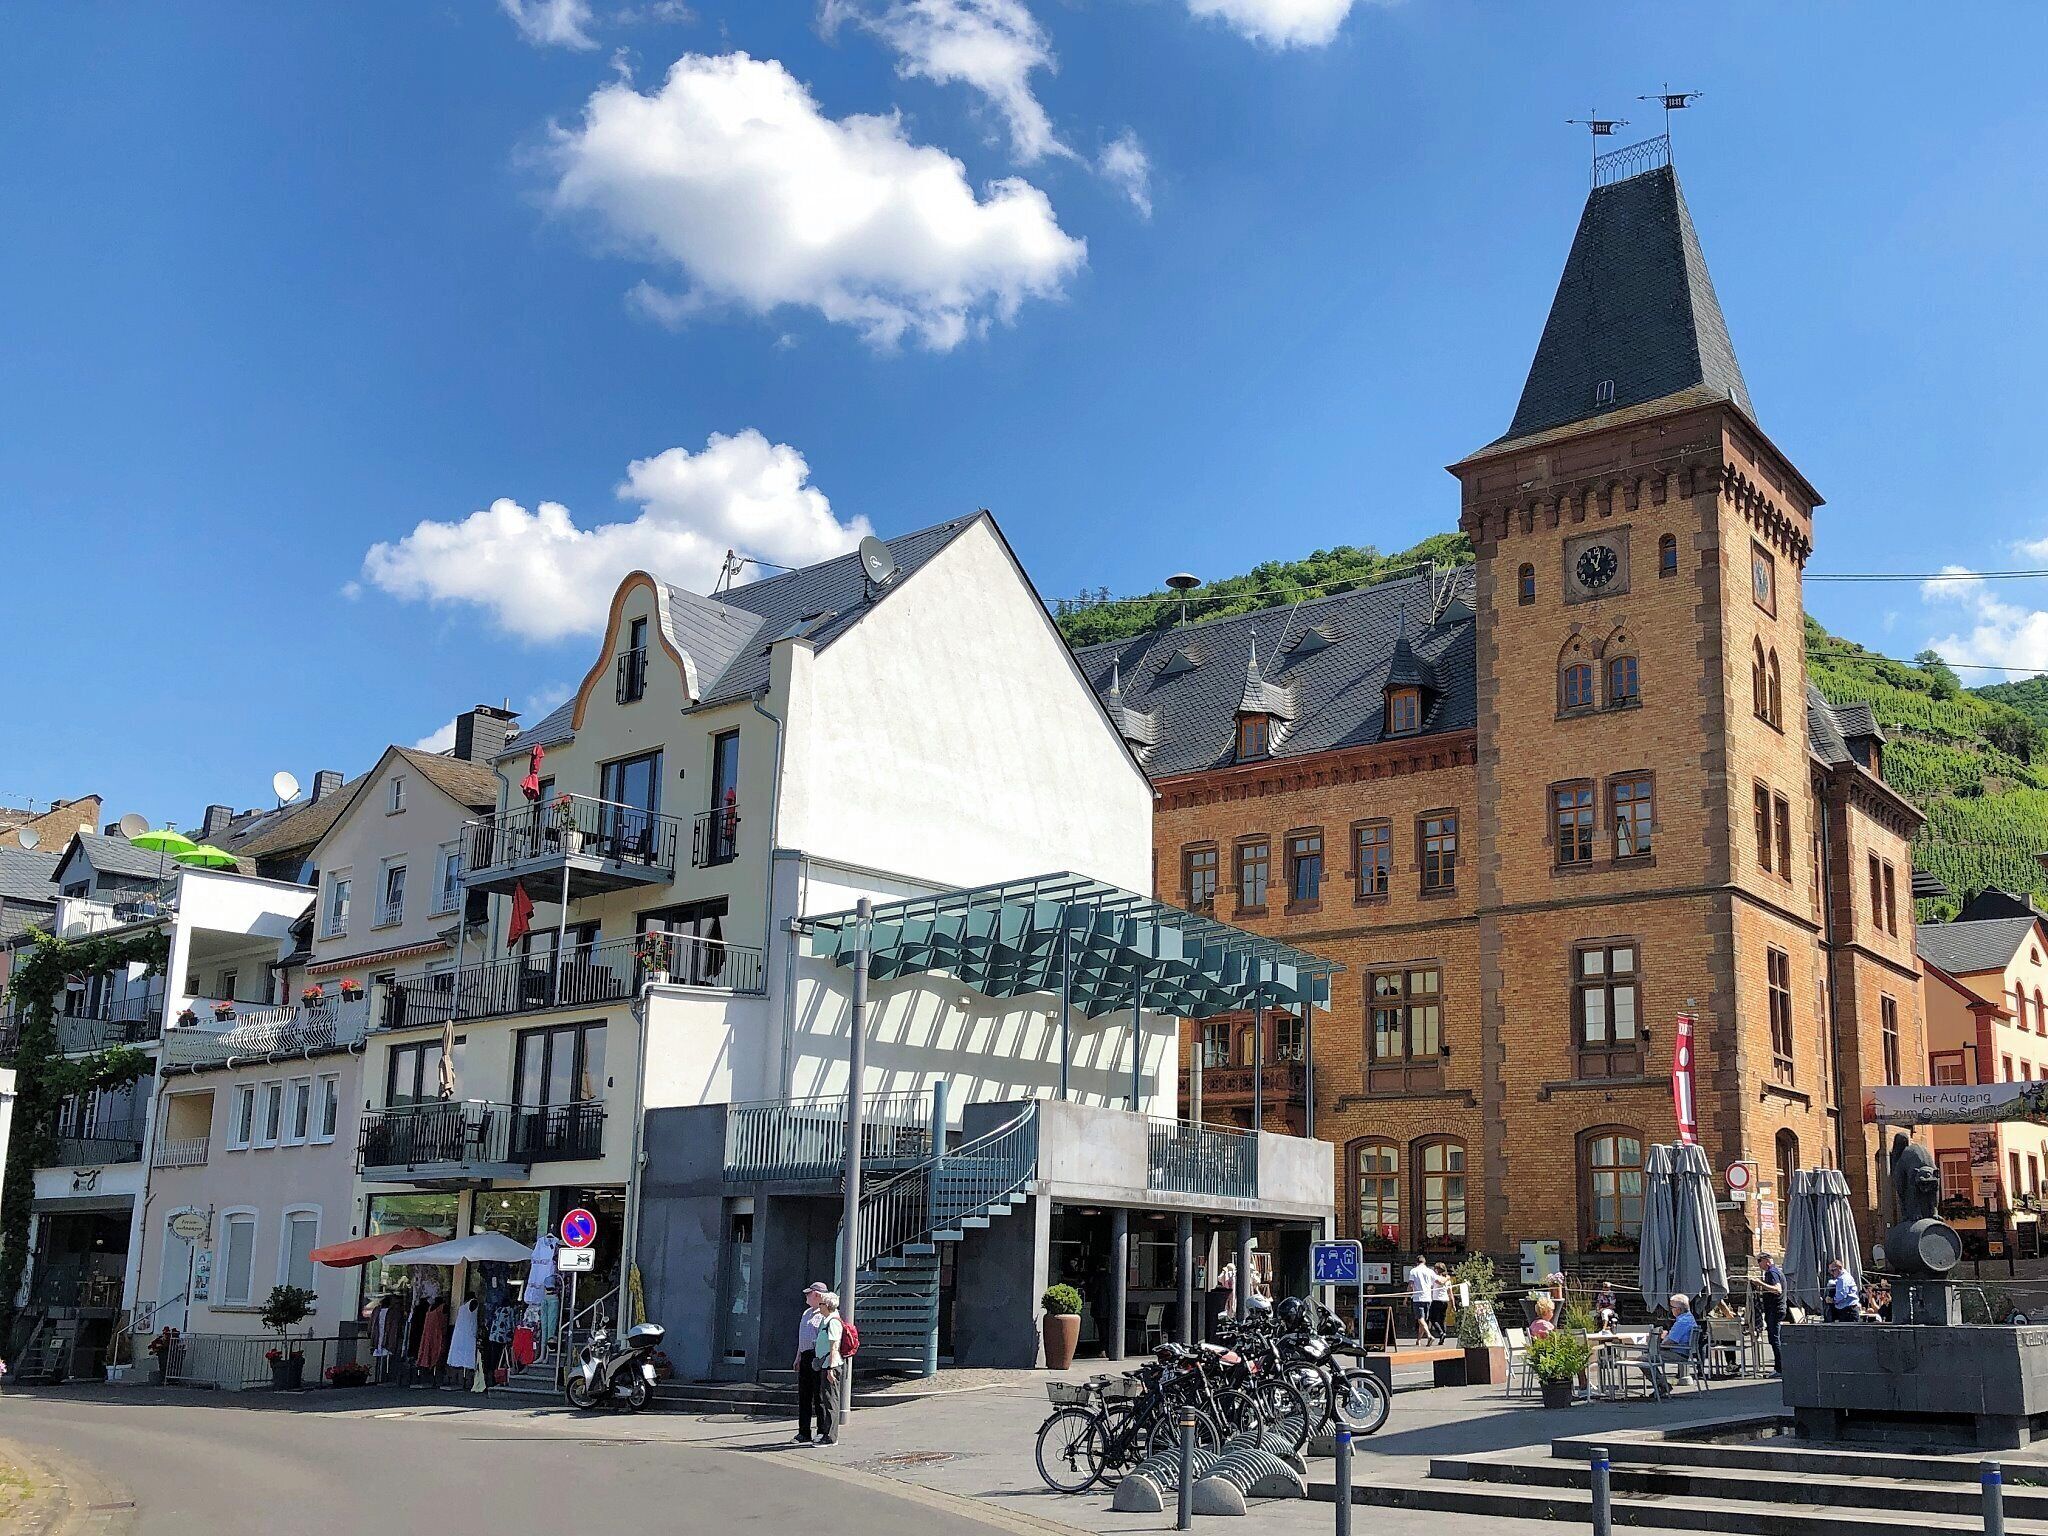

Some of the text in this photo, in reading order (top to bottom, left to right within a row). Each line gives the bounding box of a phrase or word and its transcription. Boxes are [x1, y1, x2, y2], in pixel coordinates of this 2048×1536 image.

[1913, 1091, 1991, 1106] Hier Aufgang
[1892, 1109, 1918, 1119] zum
